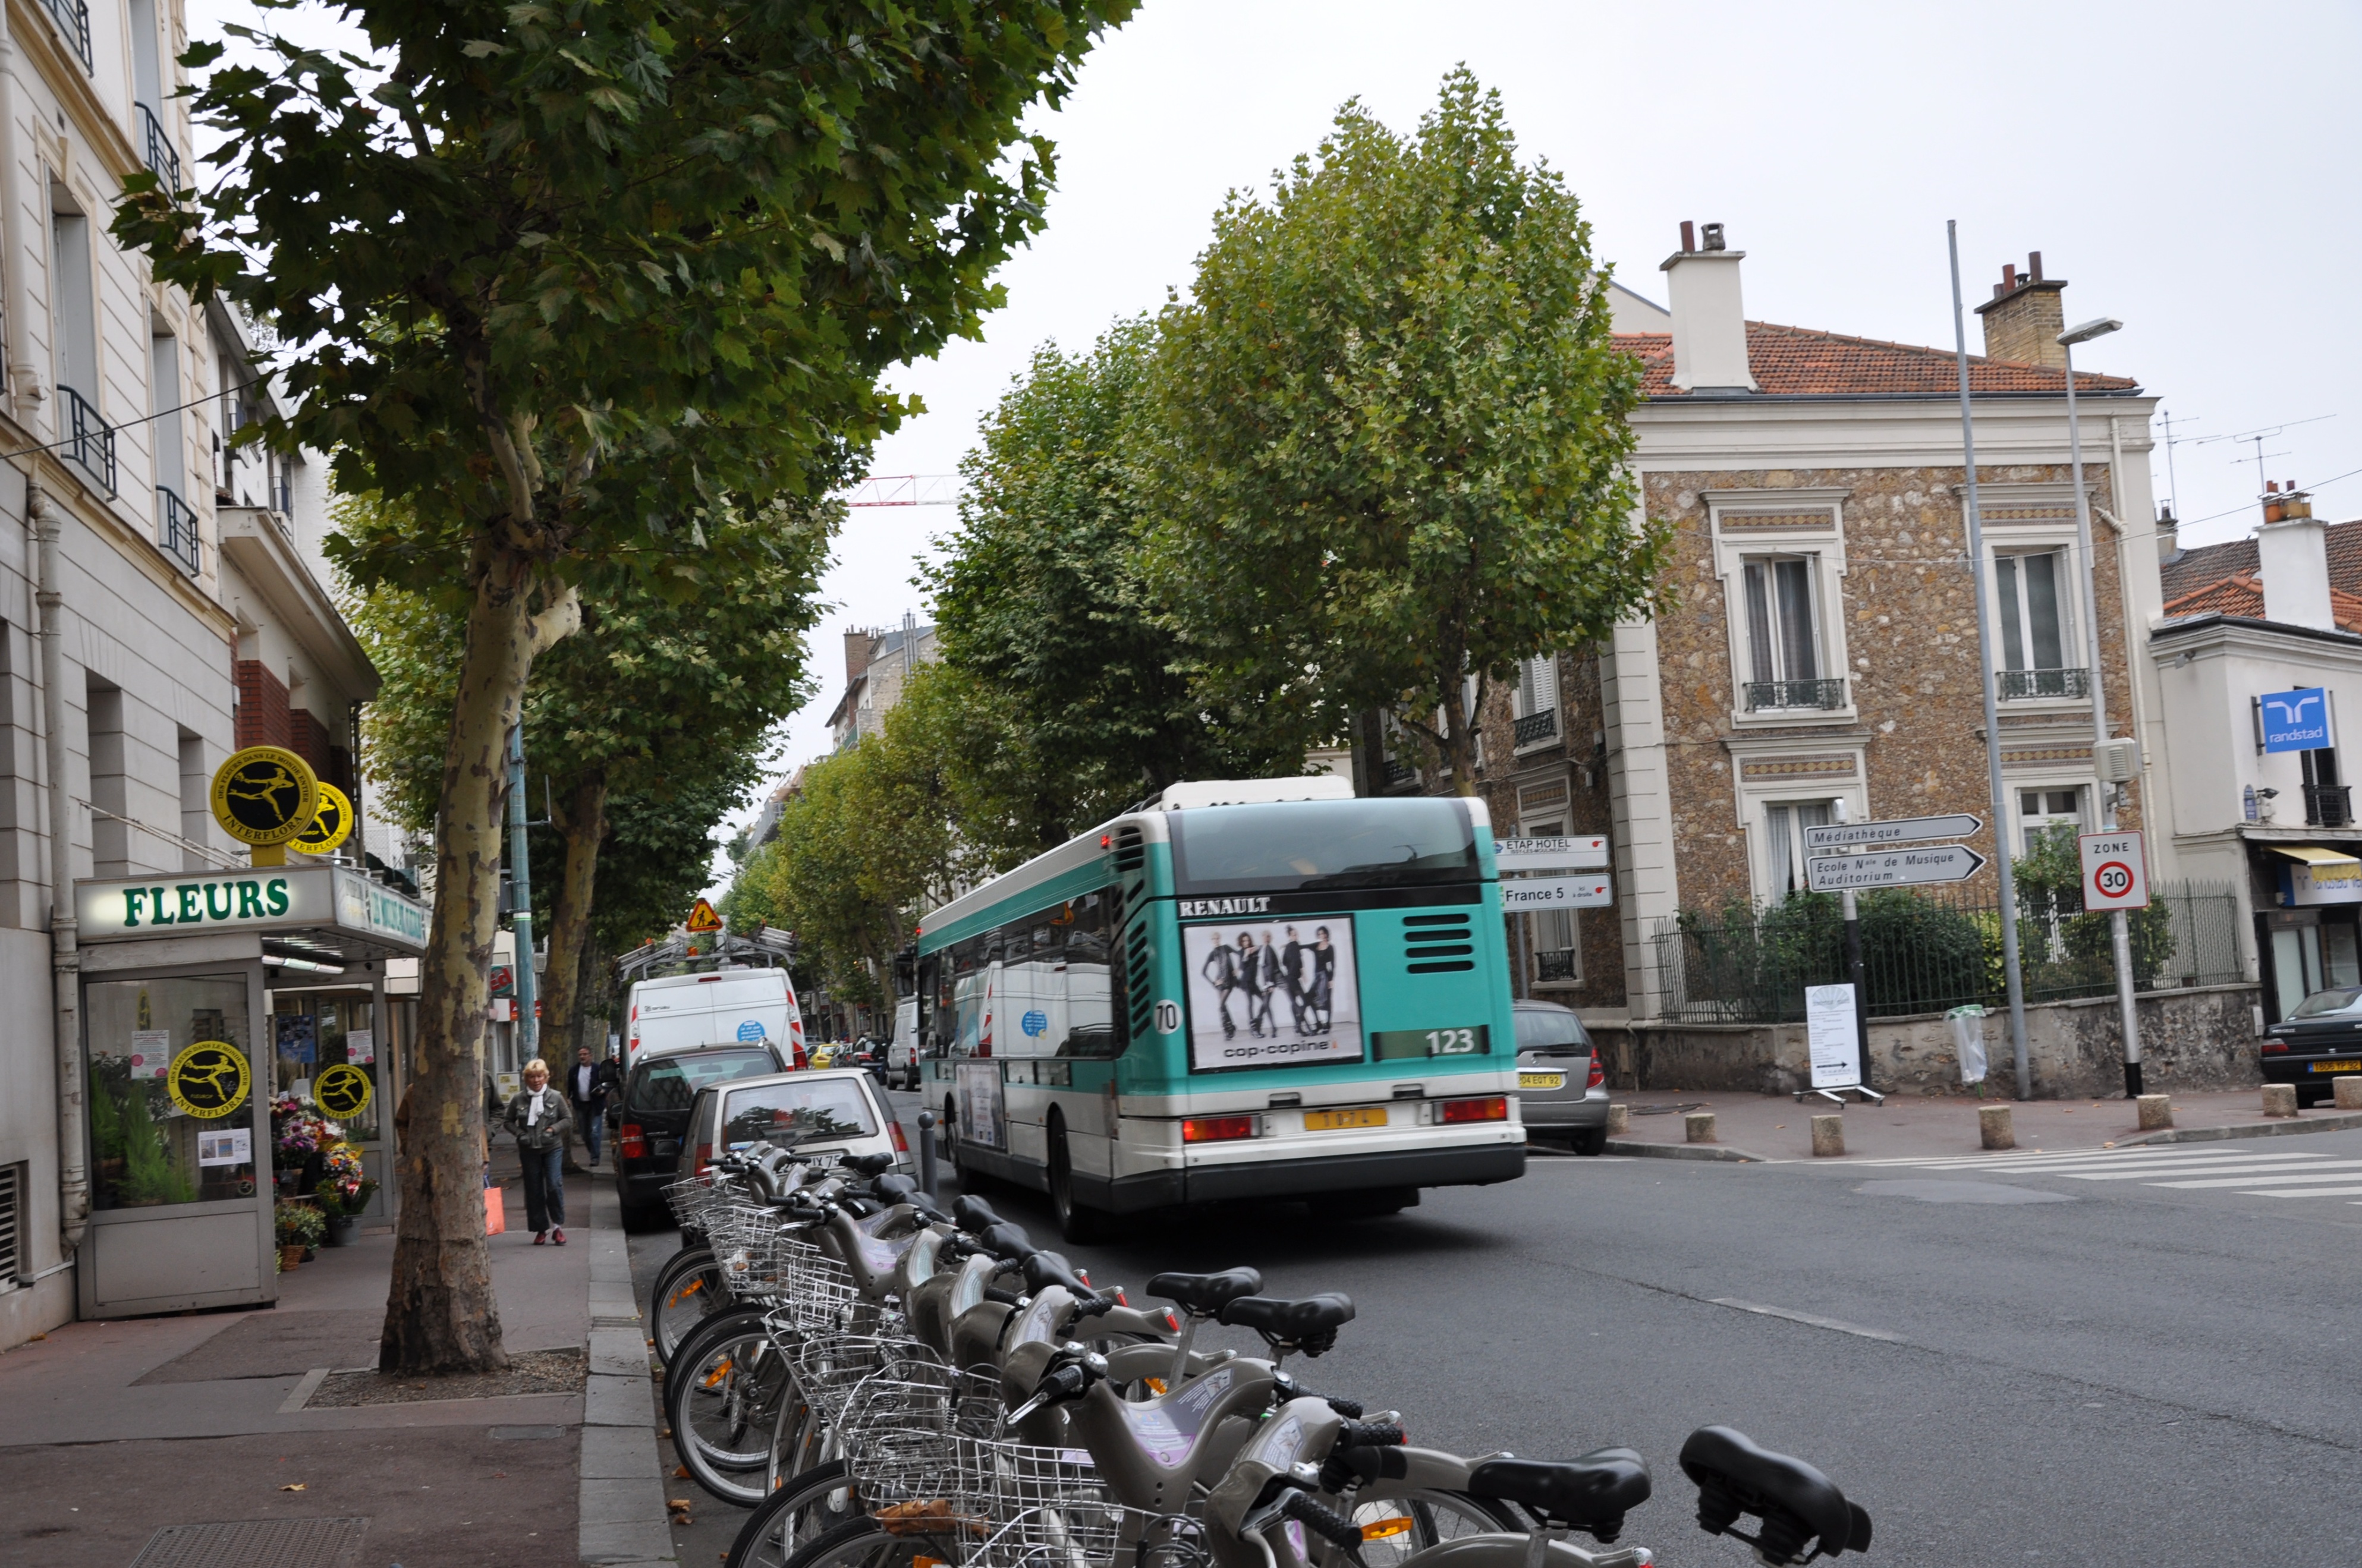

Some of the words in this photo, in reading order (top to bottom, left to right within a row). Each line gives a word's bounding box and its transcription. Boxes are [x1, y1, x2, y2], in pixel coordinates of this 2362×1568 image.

[2269, 726, 2323, 743] randstad
[222, 760, 242, 785] FLEURS
[244, 753, 264, 763] DANS
[278, 755, 300, 776] MONDE
[298, 774, 309, 803] ENTIER
[224, 814, 303, 840] INTERFLORA
[1814, 827, 1901, 843] Médiathèque
[1506, 840, 1533, 850] ETAP
[1536, 839, 1571, 848] HOTEL
[2094, 842, 2130, 854] ZONE
[1817, 861, 1847, 873] Ecole
[1884, 857, 1898, 867] de
[1905, 853, 1954, 866] Musique
[1819, 871, 1893, 886] Auditorium
[2103, 872, 2126, 887] 30
[122, 879, 290, 928] FLEURS
[1506, 890, 1552, 902] France
[1556, 887, 1564, 899] 5
[1179, 897, 1270, 917] RENAULT
[1155, 1003, 1177, 1030] 70
[1425, 1029, 1475, 1054] 123
[174, 1095, 243, 1117] INTERFLORA
[826, 1155, 841, 1168] 75
